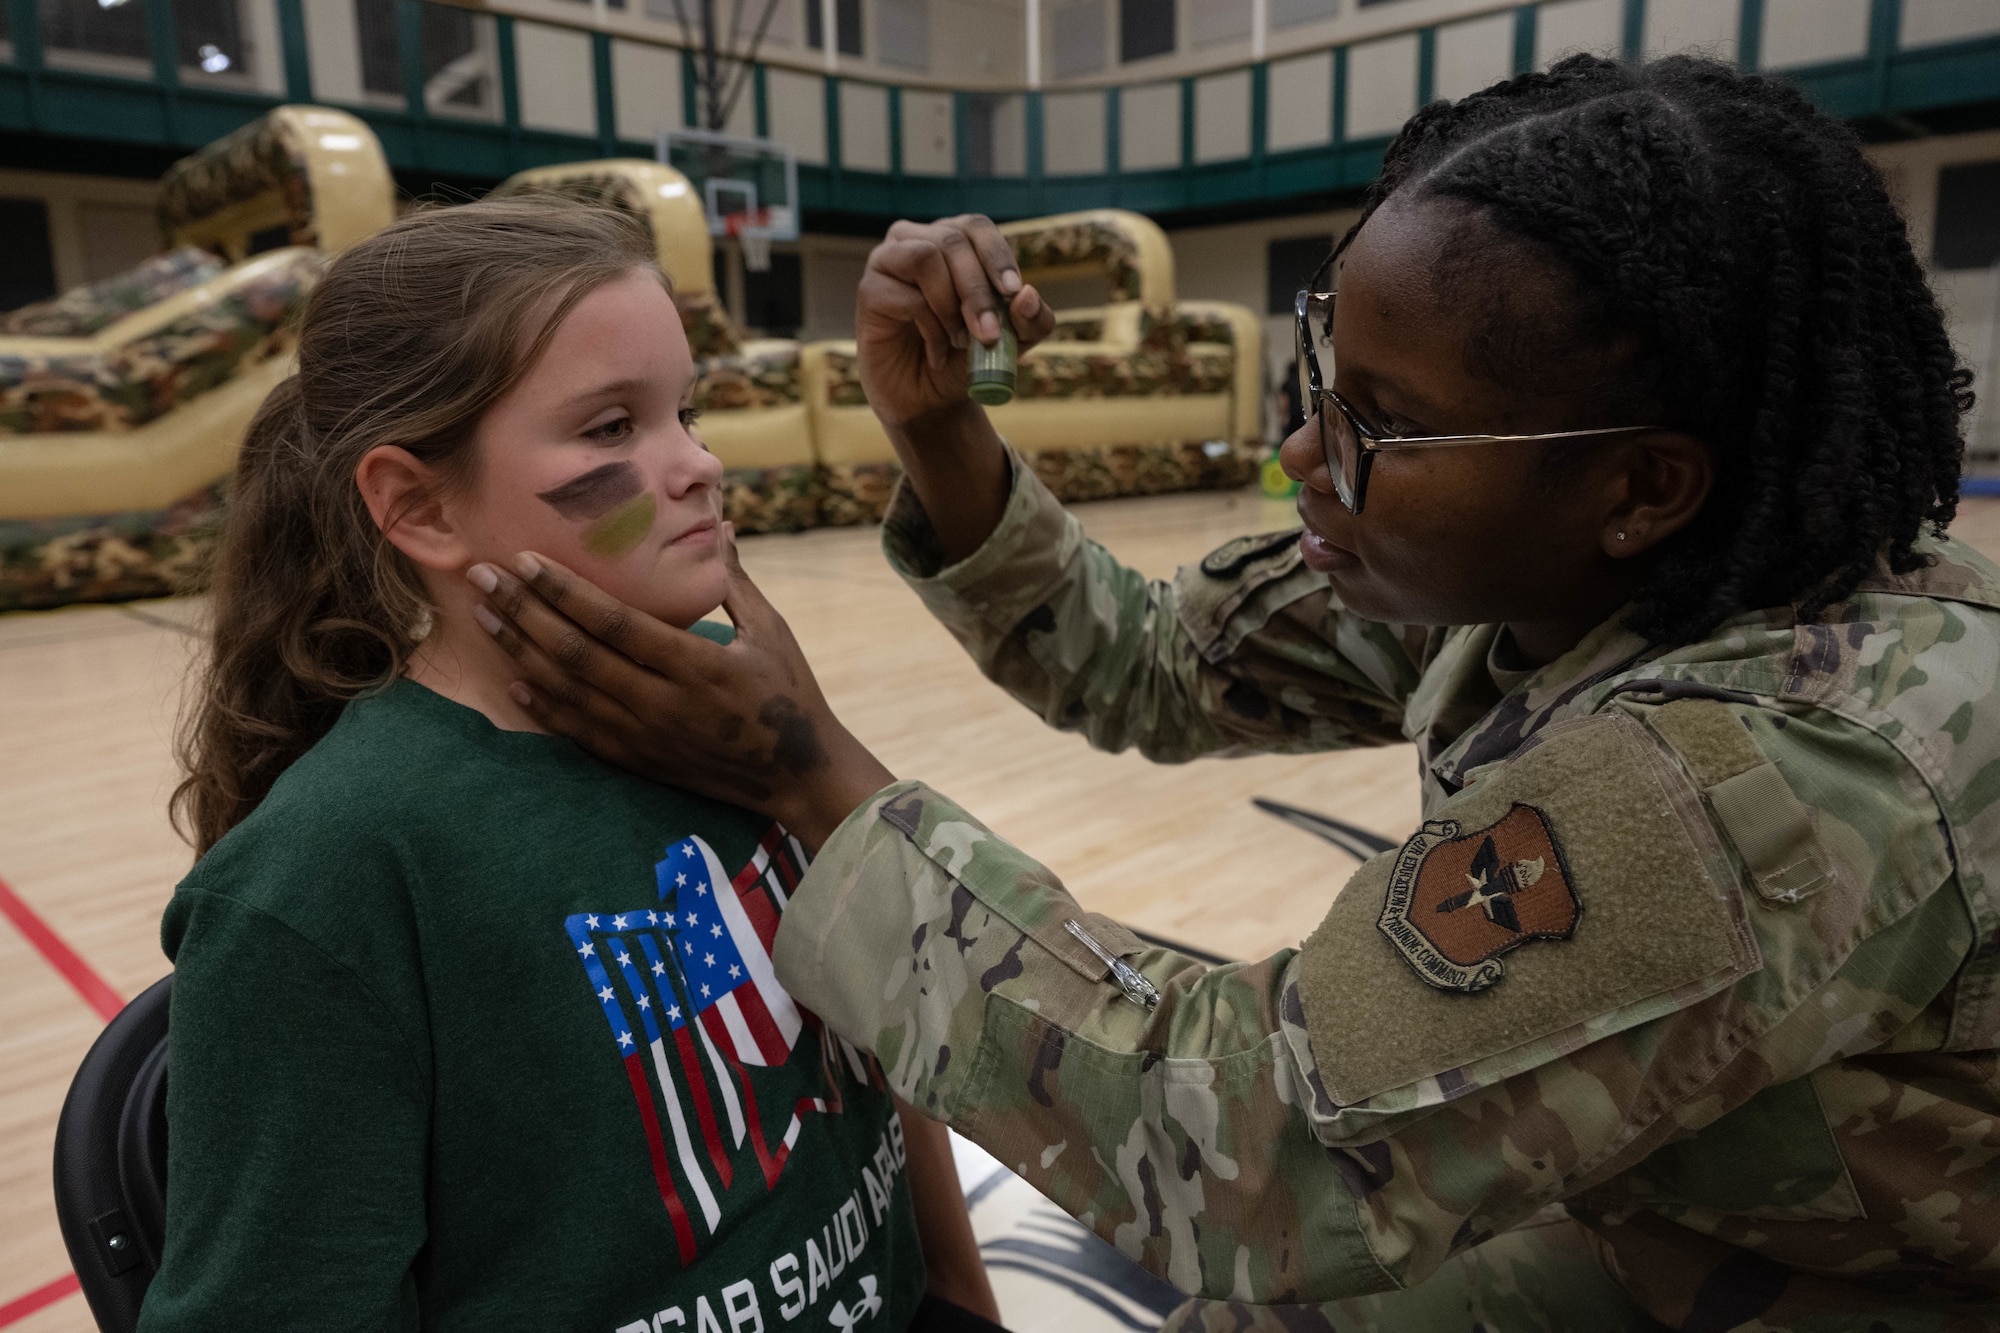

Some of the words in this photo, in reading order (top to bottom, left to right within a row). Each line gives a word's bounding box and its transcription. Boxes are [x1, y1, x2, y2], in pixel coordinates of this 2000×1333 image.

[1407, 836, 1427, 855] AIR
[1391, 856, 1418, 907] EDUCATION
[1388, 907, 1404, 916] &
[1384, 916, 1424, 954] TRAINING
[1417, 949, 1467, 985] COMMAND
[615, 1278, 765, 1333] AB
[769, 1187, 869, 1322] SAUDI
